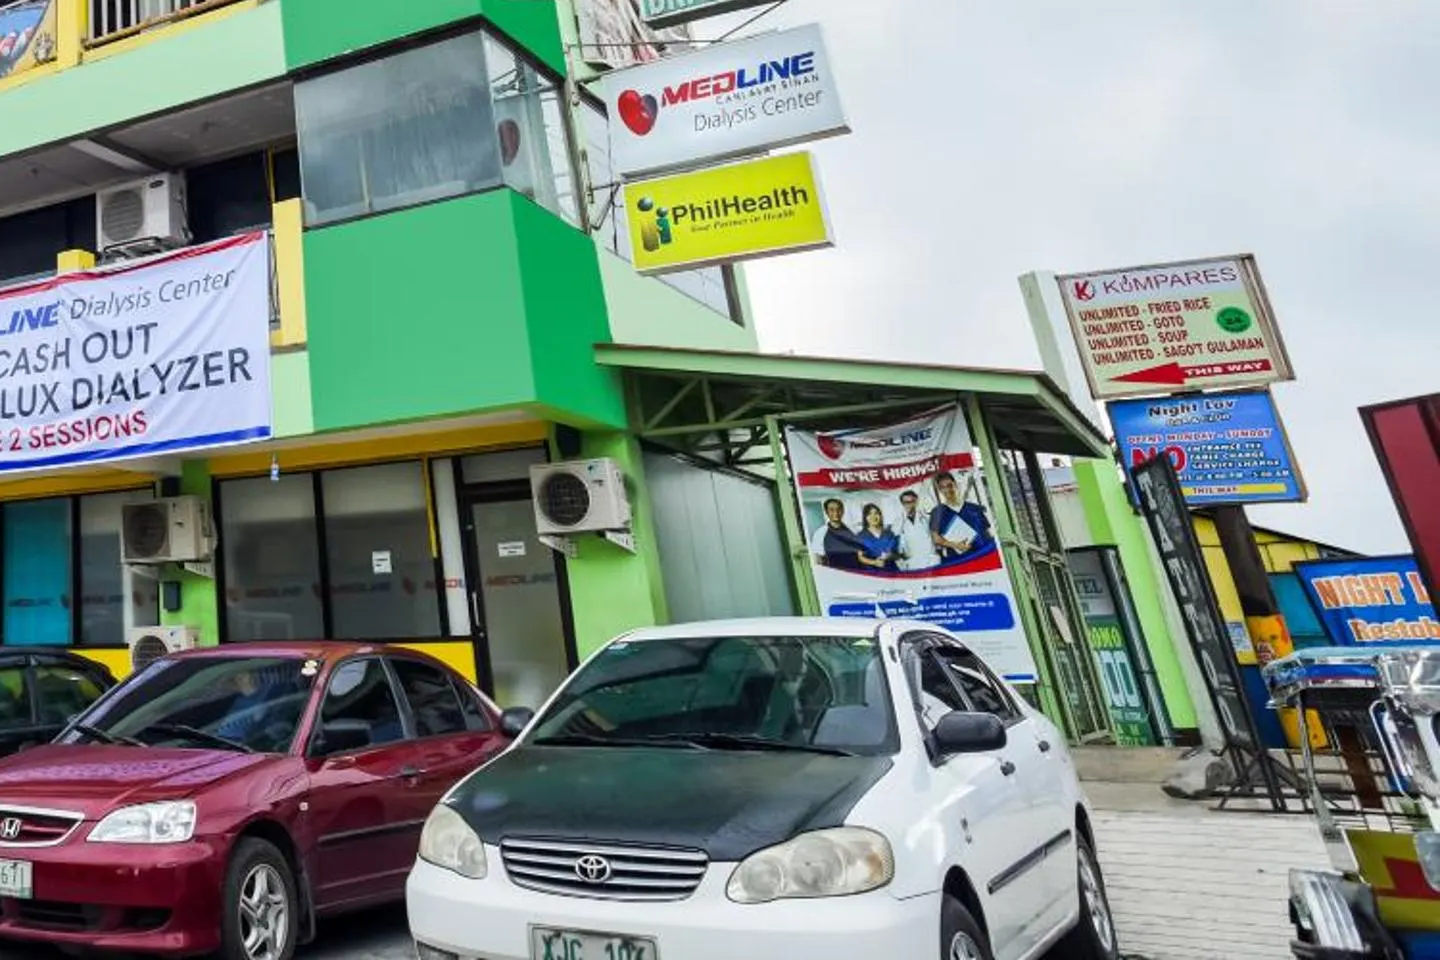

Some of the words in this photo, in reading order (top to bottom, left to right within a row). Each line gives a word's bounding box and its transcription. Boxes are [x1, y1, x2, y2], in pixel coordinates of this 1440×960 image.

[661, 51, 815, 107] MEDLINE
[694, 104, 757, 131] Dialysis
[761, 90, 823, 116] Center
[672, 186, 809, 225] PhilHealth
[70, 285, 151, 320] Dialysis
[159, 269, 235, 303] Center
[1079, 304, 1140, 321] UNLIMITED
[1148, 300, 1181, 314] FRIED
[1183, 296, 1212, 310] RICE
[82, 323, 158, 363] OUT
[1084, 320, 1144, 336] UNLIMITED
[1153, 316, 1185, 329] GOTO
[1089, 334, 1149, 350] UNLIMITED
[1158, 329, 1188, 343] SOUP
[1092, 349, 1155, 365] UNLIMITED
[1207, 337, 1264, 354] GULAMAN
[1184, 366, 1222, 376] THIS
[1227, 362, 1263, 371] WAY
[71, 347, 252, 408] DIALYZER
[1149, 404, 1197, 417] Night
[9, 430, 22, 451] 2
[28, 410, 148, 448] SESSIONS
[828, 471, 880, 483] WE'RE
[883, 459, 940, 481] HIRING!
[1311, 572, 1406, 610] NIGHT
